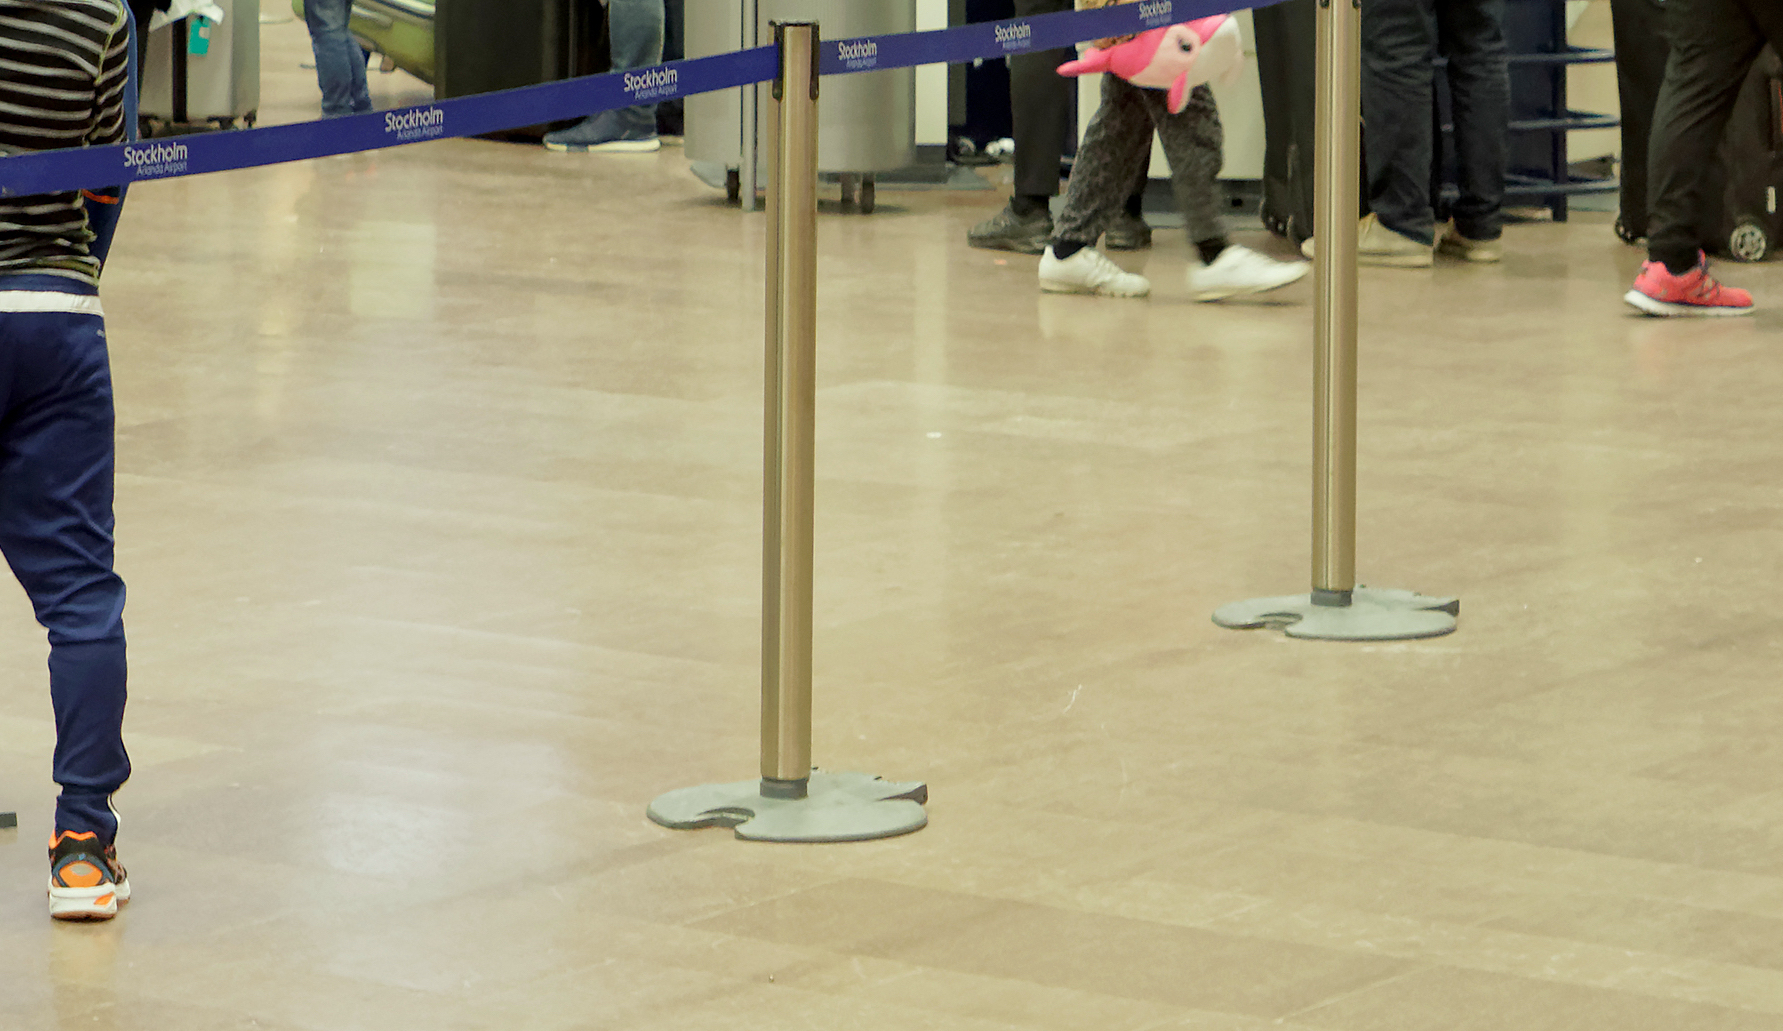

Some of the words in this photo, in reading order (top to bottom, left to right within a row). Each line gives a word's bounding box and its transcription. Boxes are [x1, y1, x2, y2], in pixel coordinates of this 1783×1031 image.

[838, 39, 878, 61] Stockholm
[623, 66, 678, 93] Stockholm
[384, 106, 443, 133] Stockholm
[124, 141, 188, 168] Stockholm
